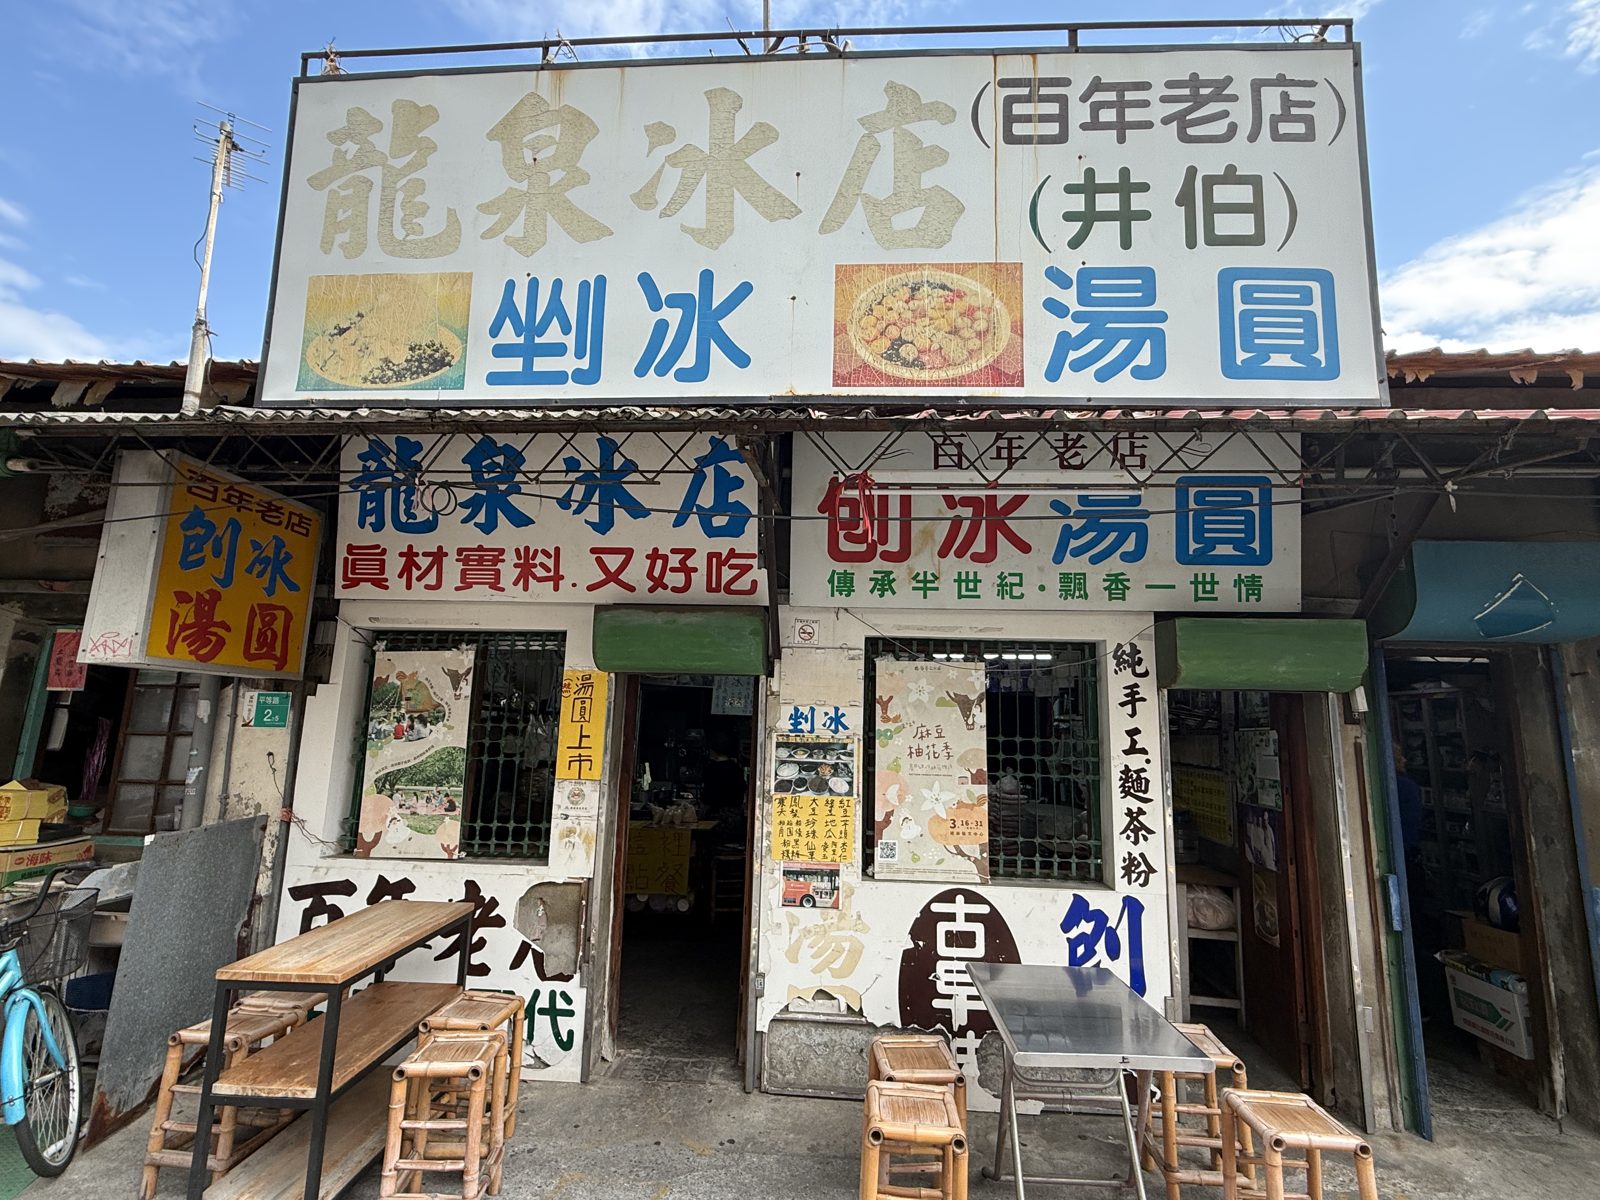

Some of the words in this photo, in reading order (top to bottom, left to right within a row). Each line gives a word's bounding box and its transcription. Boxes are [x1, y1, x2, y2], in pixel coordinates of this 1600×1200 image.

[307, 79, 966, 259] 龍泉冰店
[1029, 163, 1298, 253] (井伯)
[1042, 265, 1341, 384] 湯圓
[349, 434, 755, 538] 龍泉冰店
[933, 431, 1150, 470] 百年老店
[187, 468, 313, 538] 百年老店
[166, 587, 294, 671] 湯圓
[566, 673, 595, 780] 湯圓上市
[906, 741, 954, 761] 柚花季
[913, 722, 946, 741] 麻豆
